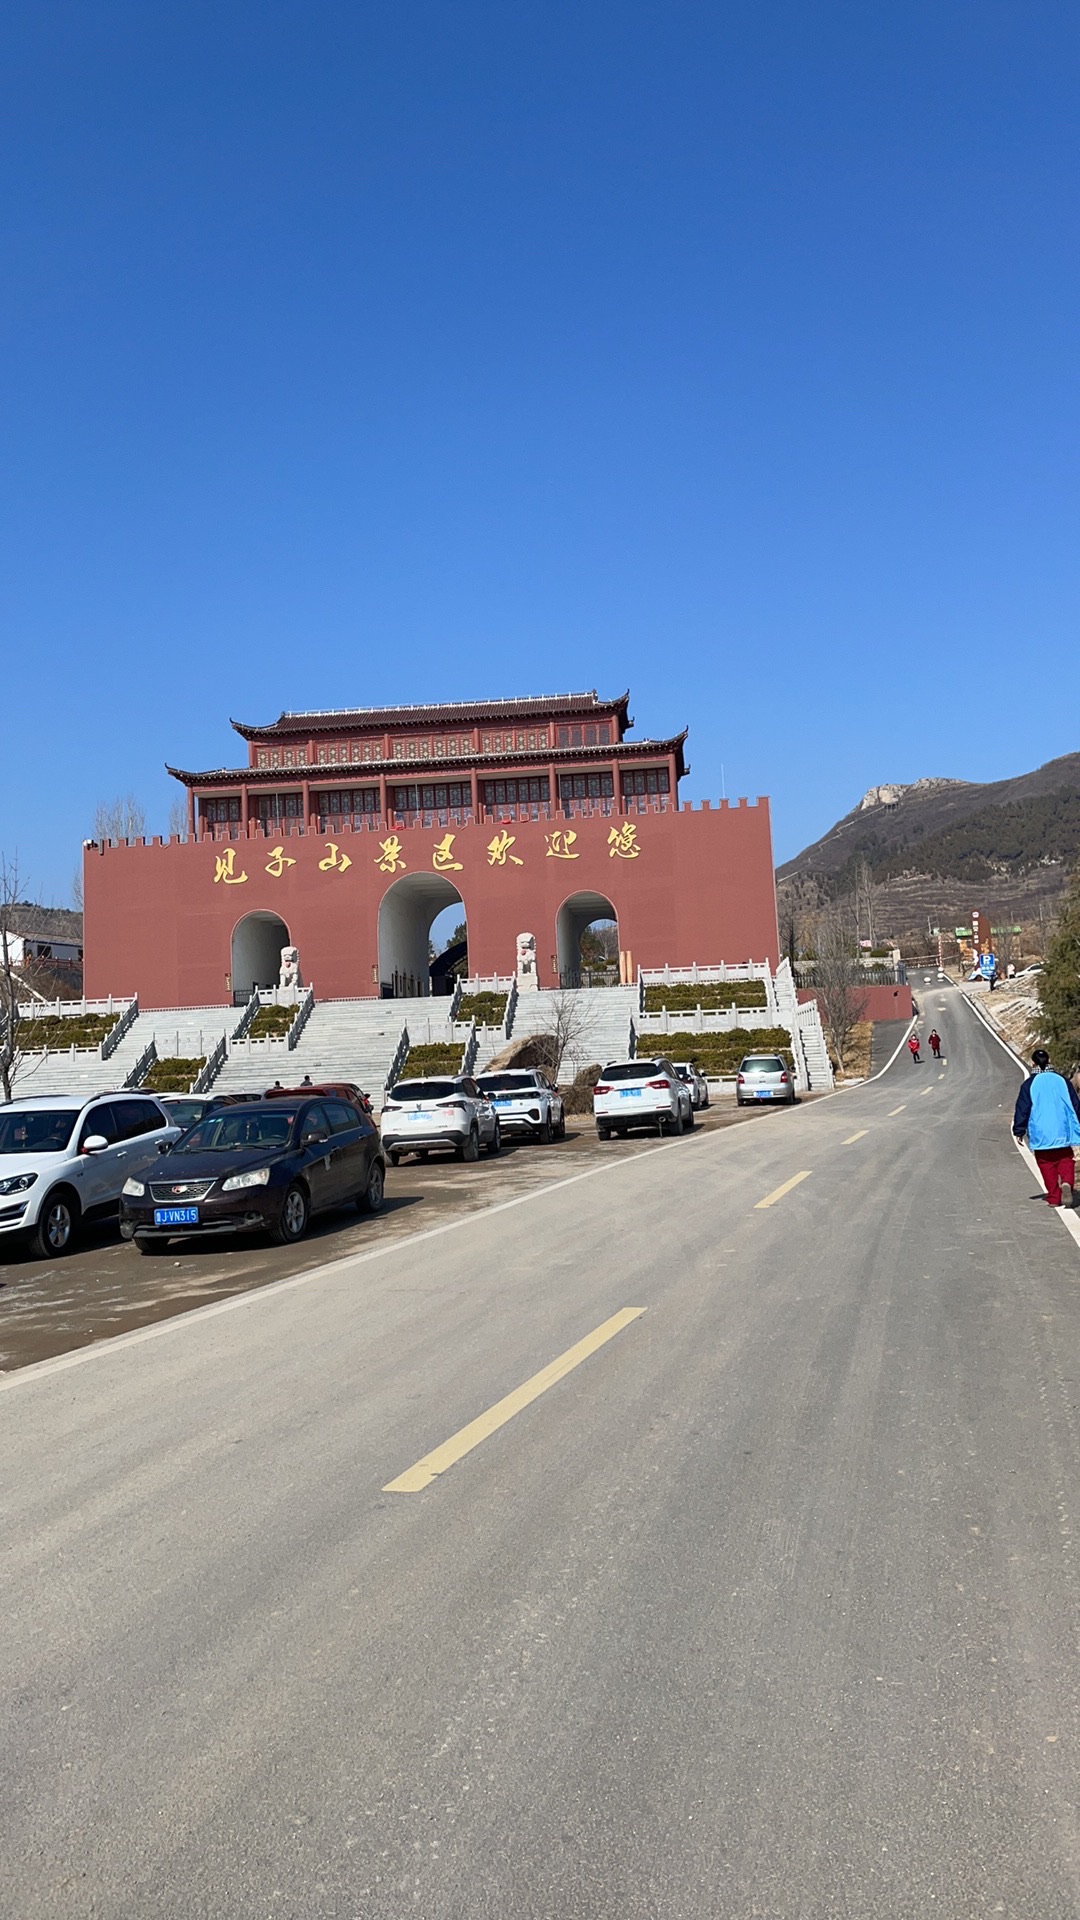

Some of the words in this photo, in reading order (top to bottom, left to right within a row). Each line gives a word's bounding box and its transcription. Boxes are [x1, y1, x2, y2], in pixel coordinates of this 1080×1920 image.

[213, 821, 642, 884] 见子山景区欢迎您
